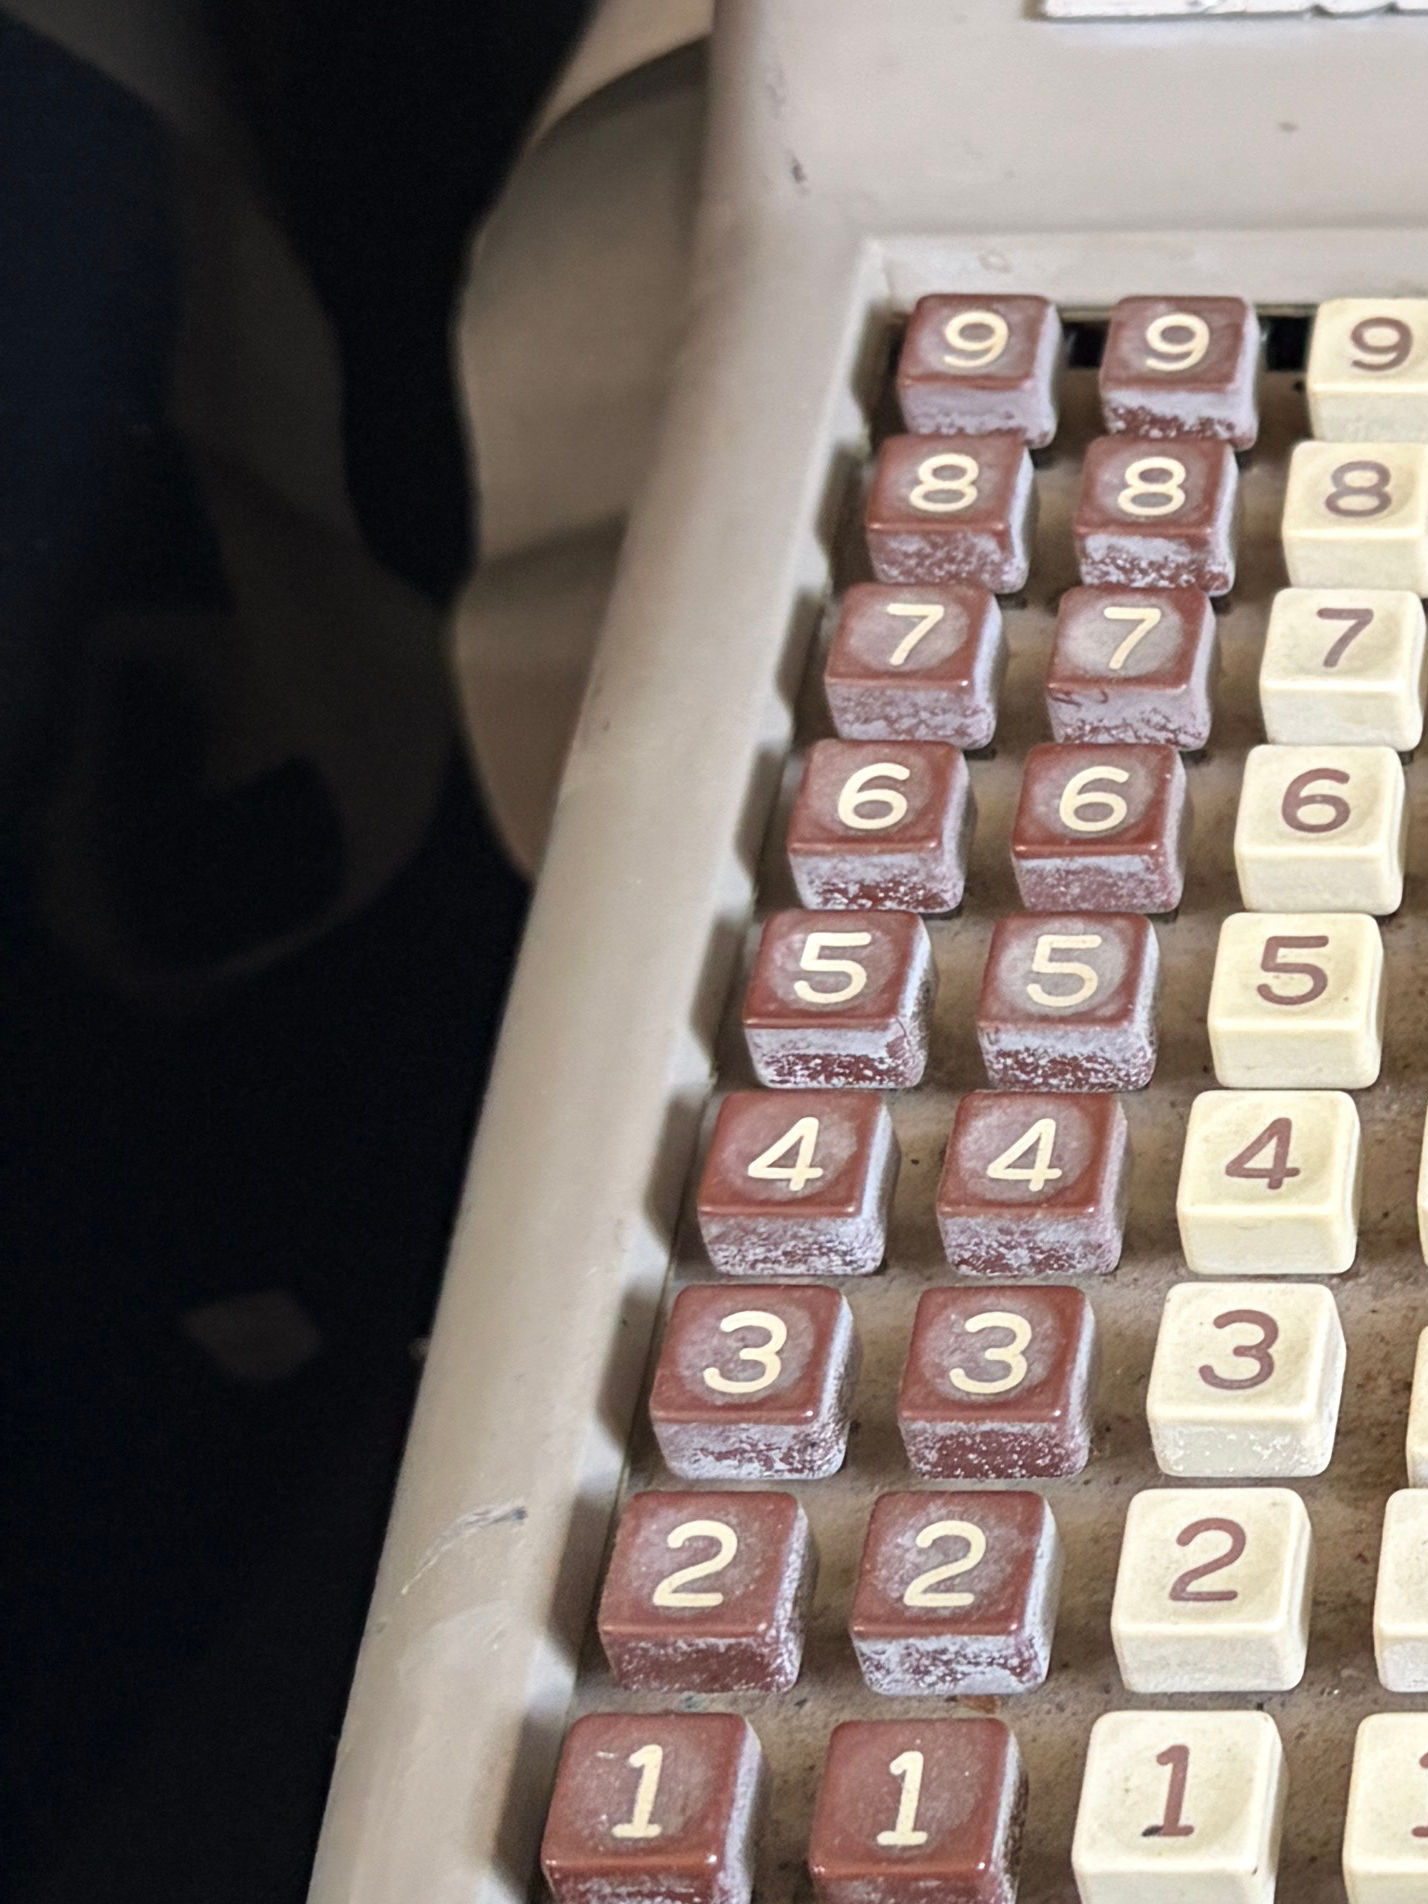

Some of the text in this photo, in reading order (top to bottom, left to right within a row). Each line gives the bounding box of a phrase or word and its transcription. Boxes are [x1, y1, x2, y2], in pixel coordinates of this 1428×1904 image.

[942, 311, 1008, 368] 9
[1144, 313, 1209, 371] 9
[1350, 316, 1413, 372] 9
[908, 453, 979, 512] 8
[1116, 456, 1186, 516] 8
[1324, 461, 1393, 519] 8
[885, 602, 945, 665] 7
[1103, 606, 1161, 669] 7
[1316, 607, 1374, 669] 7
[837, 762, 910, 829] 6
[1058, 765, 1130, 831] 6
[1281, 767, 1351, 834] 6
[793, 932, 872, 1004] 5
[1026, 934, 1102, 1007] 5
[1256, 935, 1329, 1006] 5
[747, 1117, 824, 1191] 4
[986, 1118, 1062, 1192] 4
[1225, 1117, 1301, 1191] 4
[703, 1310, 787, 1394] 3
[949, 1311, 1032, 1394] 3
[1198, 1309, 1280, 1391] 3
[653, 1519, 738, 1607] 2
[903, 1520, 986, 1607] 2
[1168, 1517, 1247, 1603] 2
[612, 1744, 664, 1838] 1
[877, 1750, 928, 1846] 1
[1140, 1744, 1195, 1838] 1
